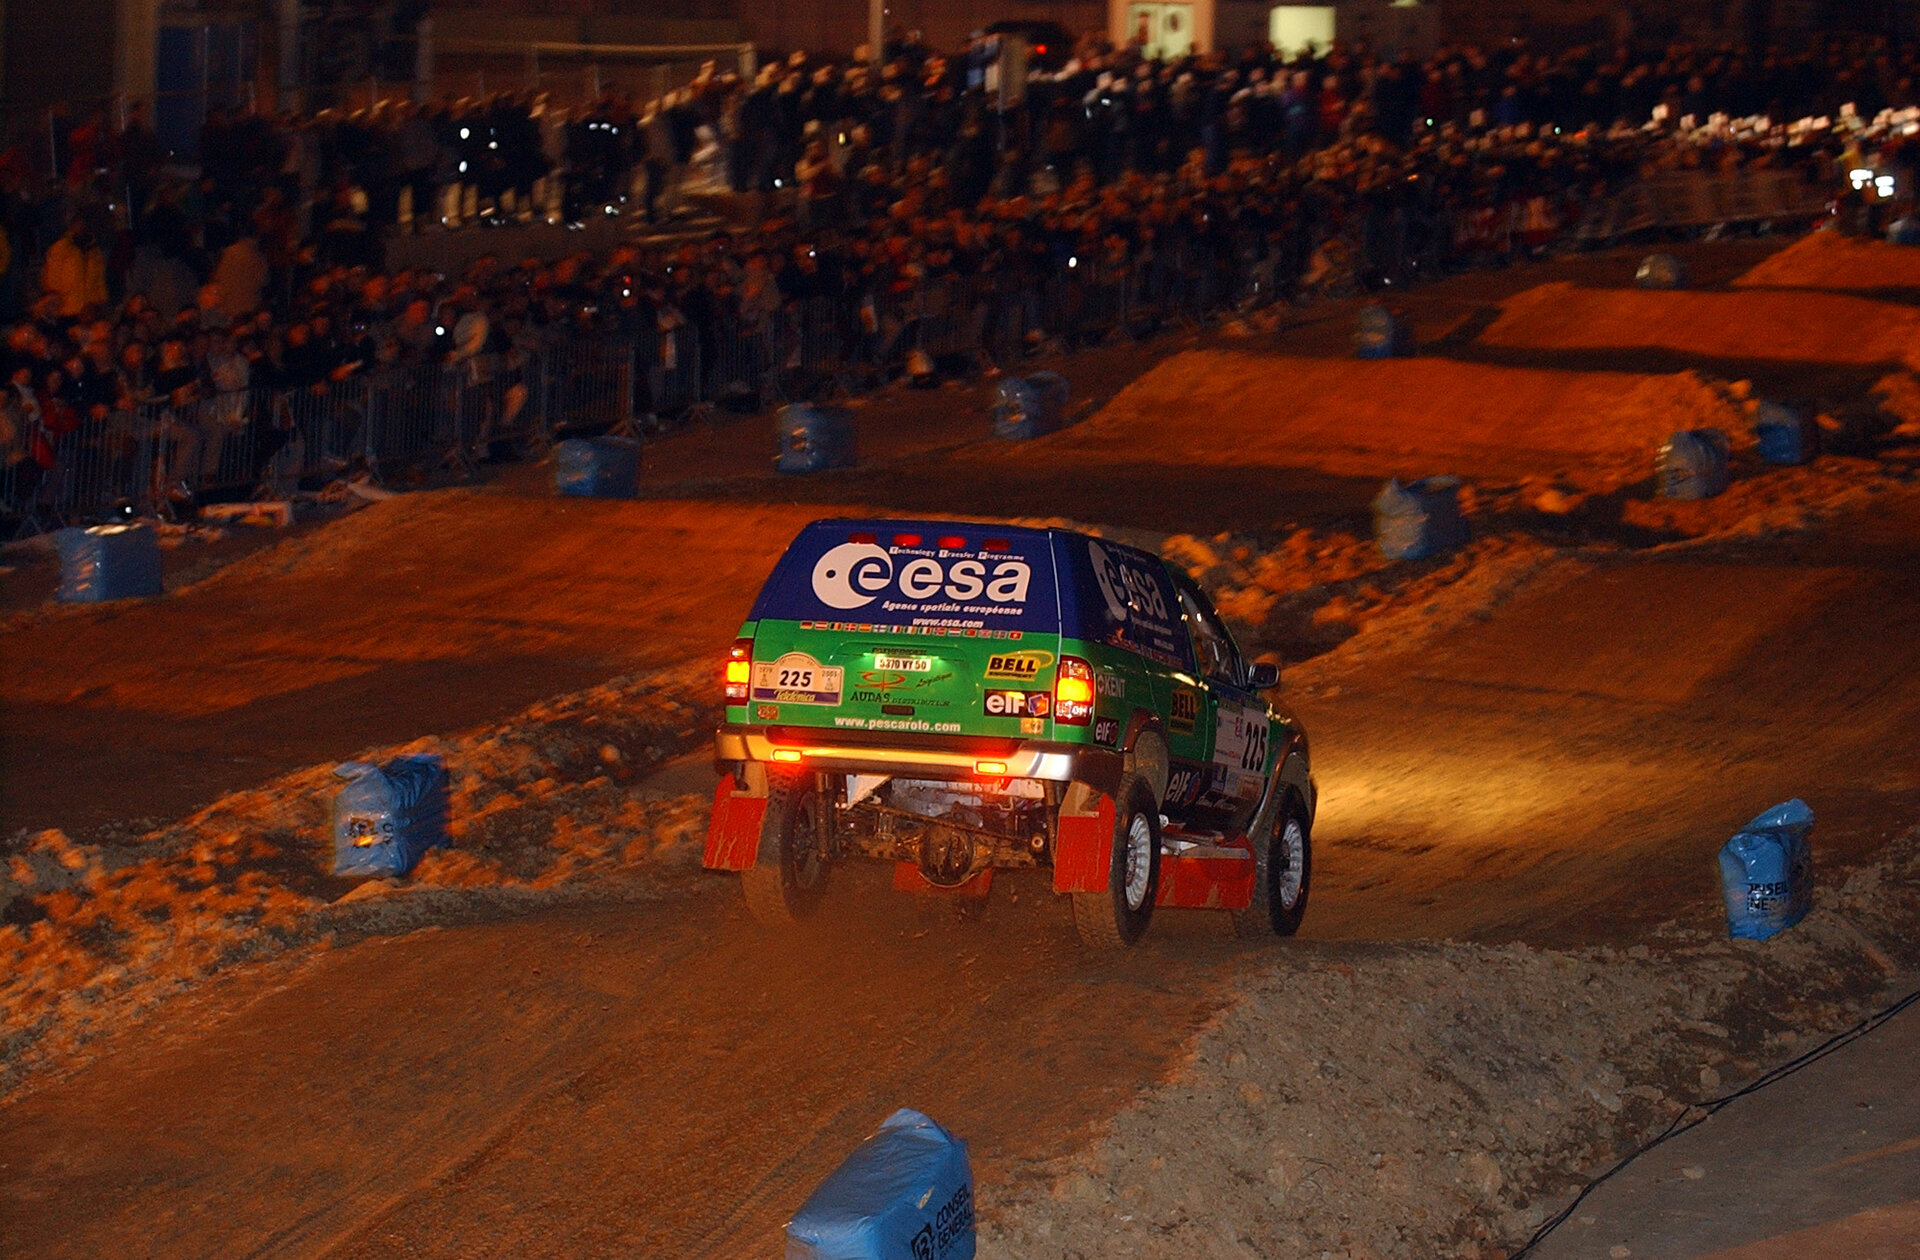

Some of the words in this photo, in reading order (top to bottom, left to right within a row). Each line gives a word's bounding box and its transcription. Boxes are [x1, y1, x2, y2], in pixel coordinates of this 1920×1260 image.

[938, 549, 975, 559] Transfer
[977, 551, 1025, 561] Programme
[899, 558, 1031, 602] esa
[882, 600, 918, 612] Agence
[920, 602, 961, 613] spatiale
[963, 604, 1023, 616] européenne
[912, 617, 984, 629] www.esa.com
[989, 657, 1037, 673] BELL
[779, 669, 812, 687] 225
[850, 691, 890, 703] AUDAS
[986, 691, 1026, 714] elf
[1171, 692, 1196, 721] BELL
[834, 716, 961, 732] www.pescarolo.com
[1095, 721, 1111, 741] elf
[1242, 720, 1268, 772] 225
[1166, 770, 1191, 803] elf
